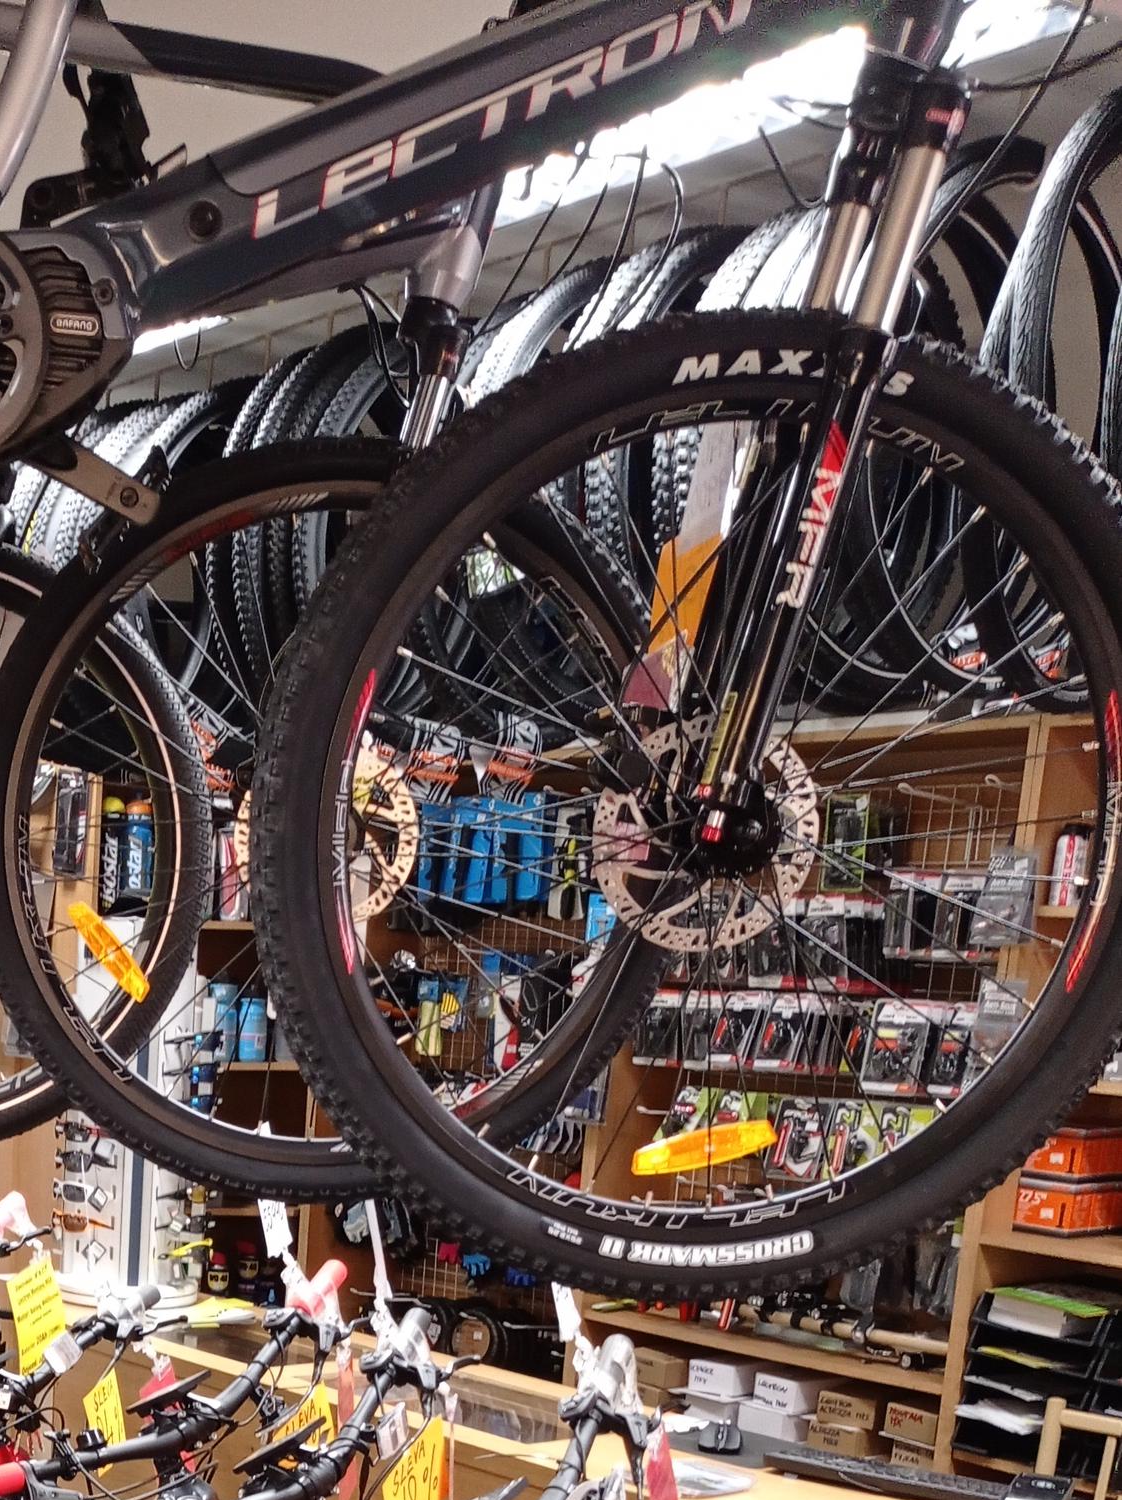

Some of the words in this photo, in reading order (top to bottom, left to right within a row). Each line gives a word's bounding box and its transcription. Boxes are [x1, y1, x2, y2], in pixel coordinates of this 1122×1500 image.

[672, 349, 915, 396] MAXS
[627, 1230, 815, 1268] CROSSMARK
[392, 1438, 427, 1497] SLEVA
